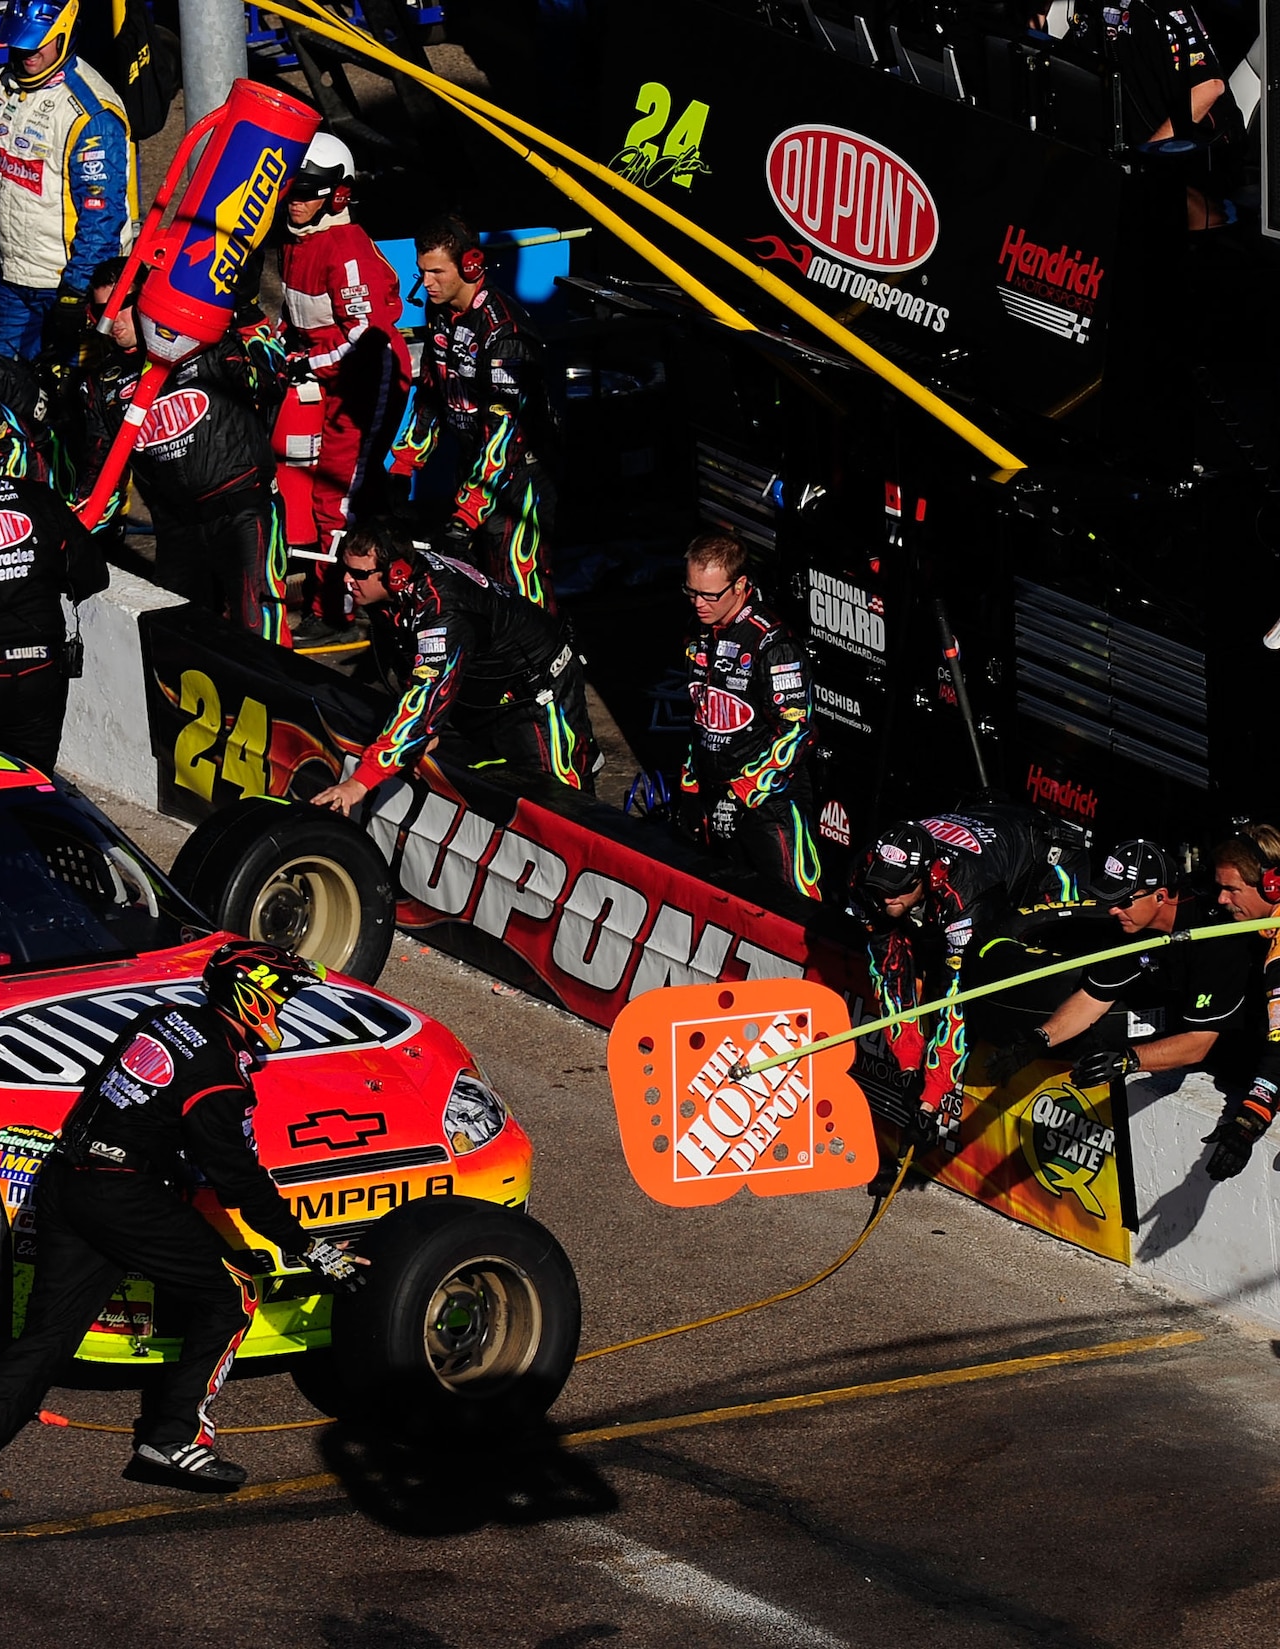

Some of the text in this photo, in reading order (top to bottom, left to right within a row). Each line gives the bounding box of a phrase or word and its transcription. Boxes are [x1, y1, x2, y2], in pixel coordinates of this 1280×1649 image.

[624, 82, 710, 188] 24
[213, 152, 283, 284] SUNOCO
[998, 224, 1105, 300] Hendrick
[806, 255, 950, 334] MOTORSPORTS
[809, 568, 869, 610] NATIONAL
[809, 588, 886, 652] GUARD
[5, 646, 49, 660] LOWES
[811, 625, 887, 667] NATIONALGUARD.com
[773, 677, 802, 692] GUARD
[814, 684, 862, 717] TOSHIBA
[174, 669, 270, 803] 24
[814, 702, 862, 730] Leading Innovation
[1026, 763, 1098, 819] Hendrick
[819, 824, 850, 846] TOOLS
[820, 801, 850, 835] MAC
[247, 964, 280, 990] 24
[164, 1011, 208, 1049] SIMMONS
[687, 1036, 745, 1102] THE
[676, 1012, 812, 1178] HOME
[6, 1125, 55, 1141] GOODYEAR
[727, 1069, 811, 1173] DEPOT
[1032, 1095, 1116, 1153] QUAKER
[1042, 1130, 1104, 1171] STATE
